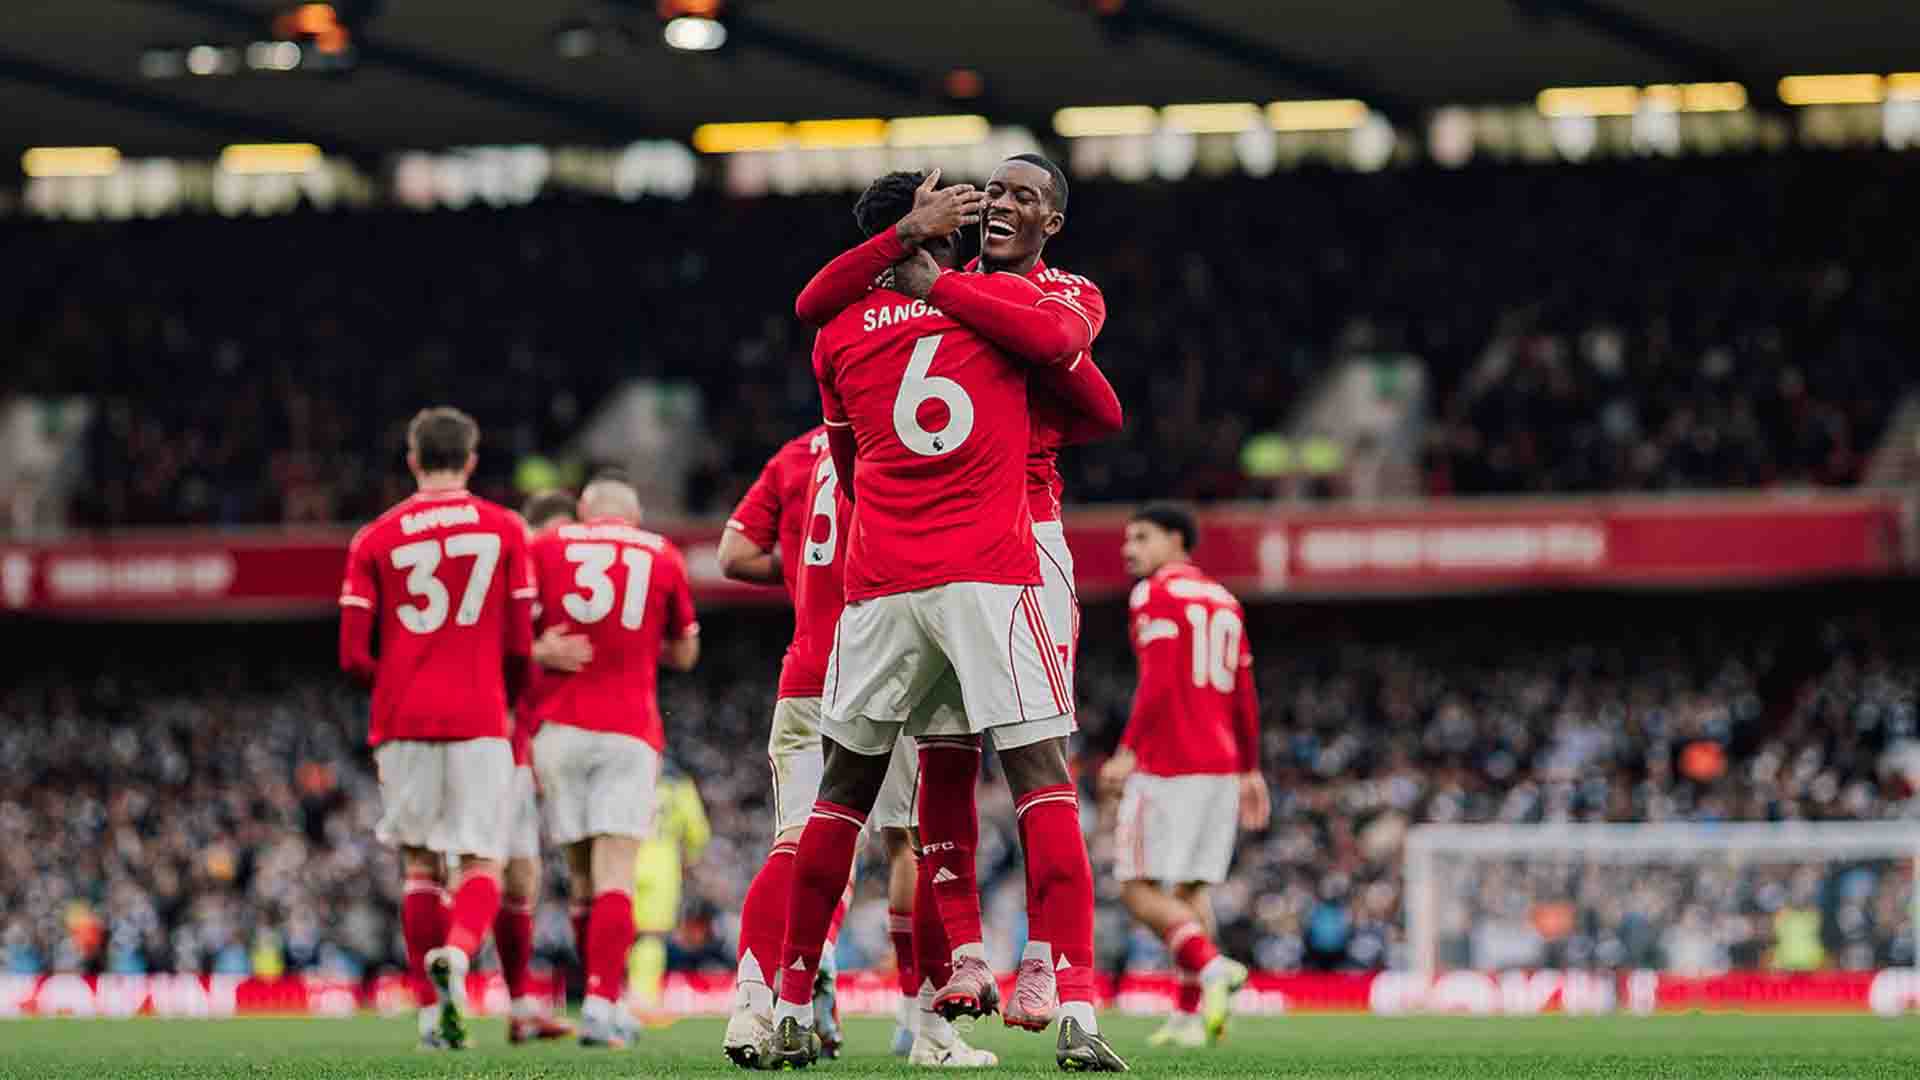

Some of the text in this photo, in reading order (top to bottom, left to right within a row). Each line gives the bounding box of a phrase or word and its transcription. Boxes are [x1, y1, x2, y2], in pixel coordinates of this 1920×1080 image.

[893, 334, 974, 456] 6
[391, 532, 501, 634] 37
[562, 542, 653, 630] 31
[1184, 603, 1242, 694] 10
